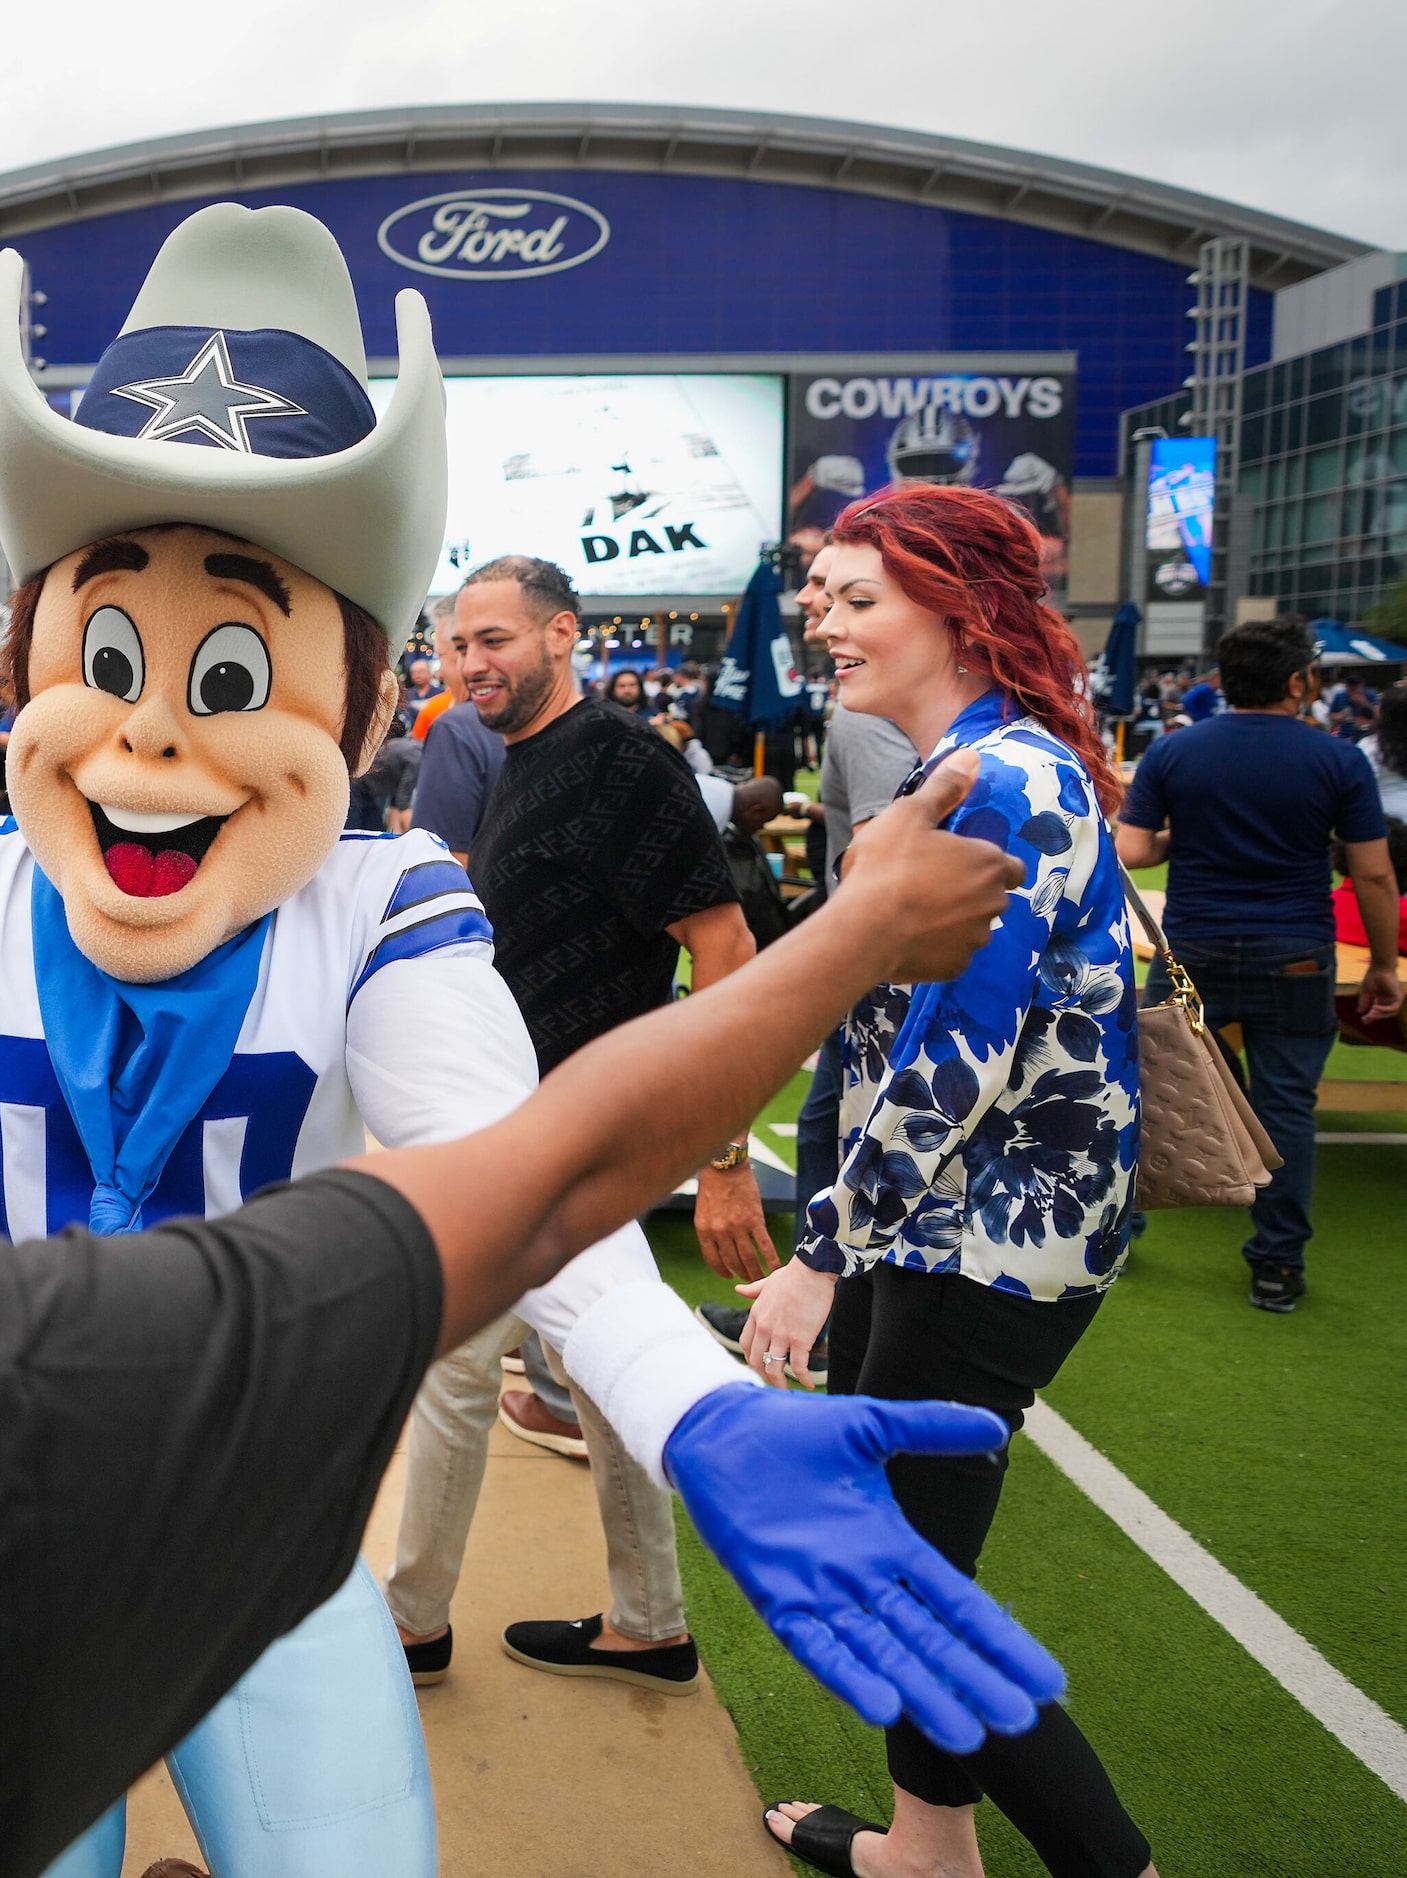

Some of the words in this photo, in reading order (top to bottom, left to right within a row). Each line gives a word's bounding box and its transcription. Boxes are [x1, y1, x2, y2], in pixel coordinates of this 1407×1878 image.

[418, 201, 568, 263] Ford
[805, 377, 1064, 419] COWBOYS
[581, 523, 707, 564] DAK
